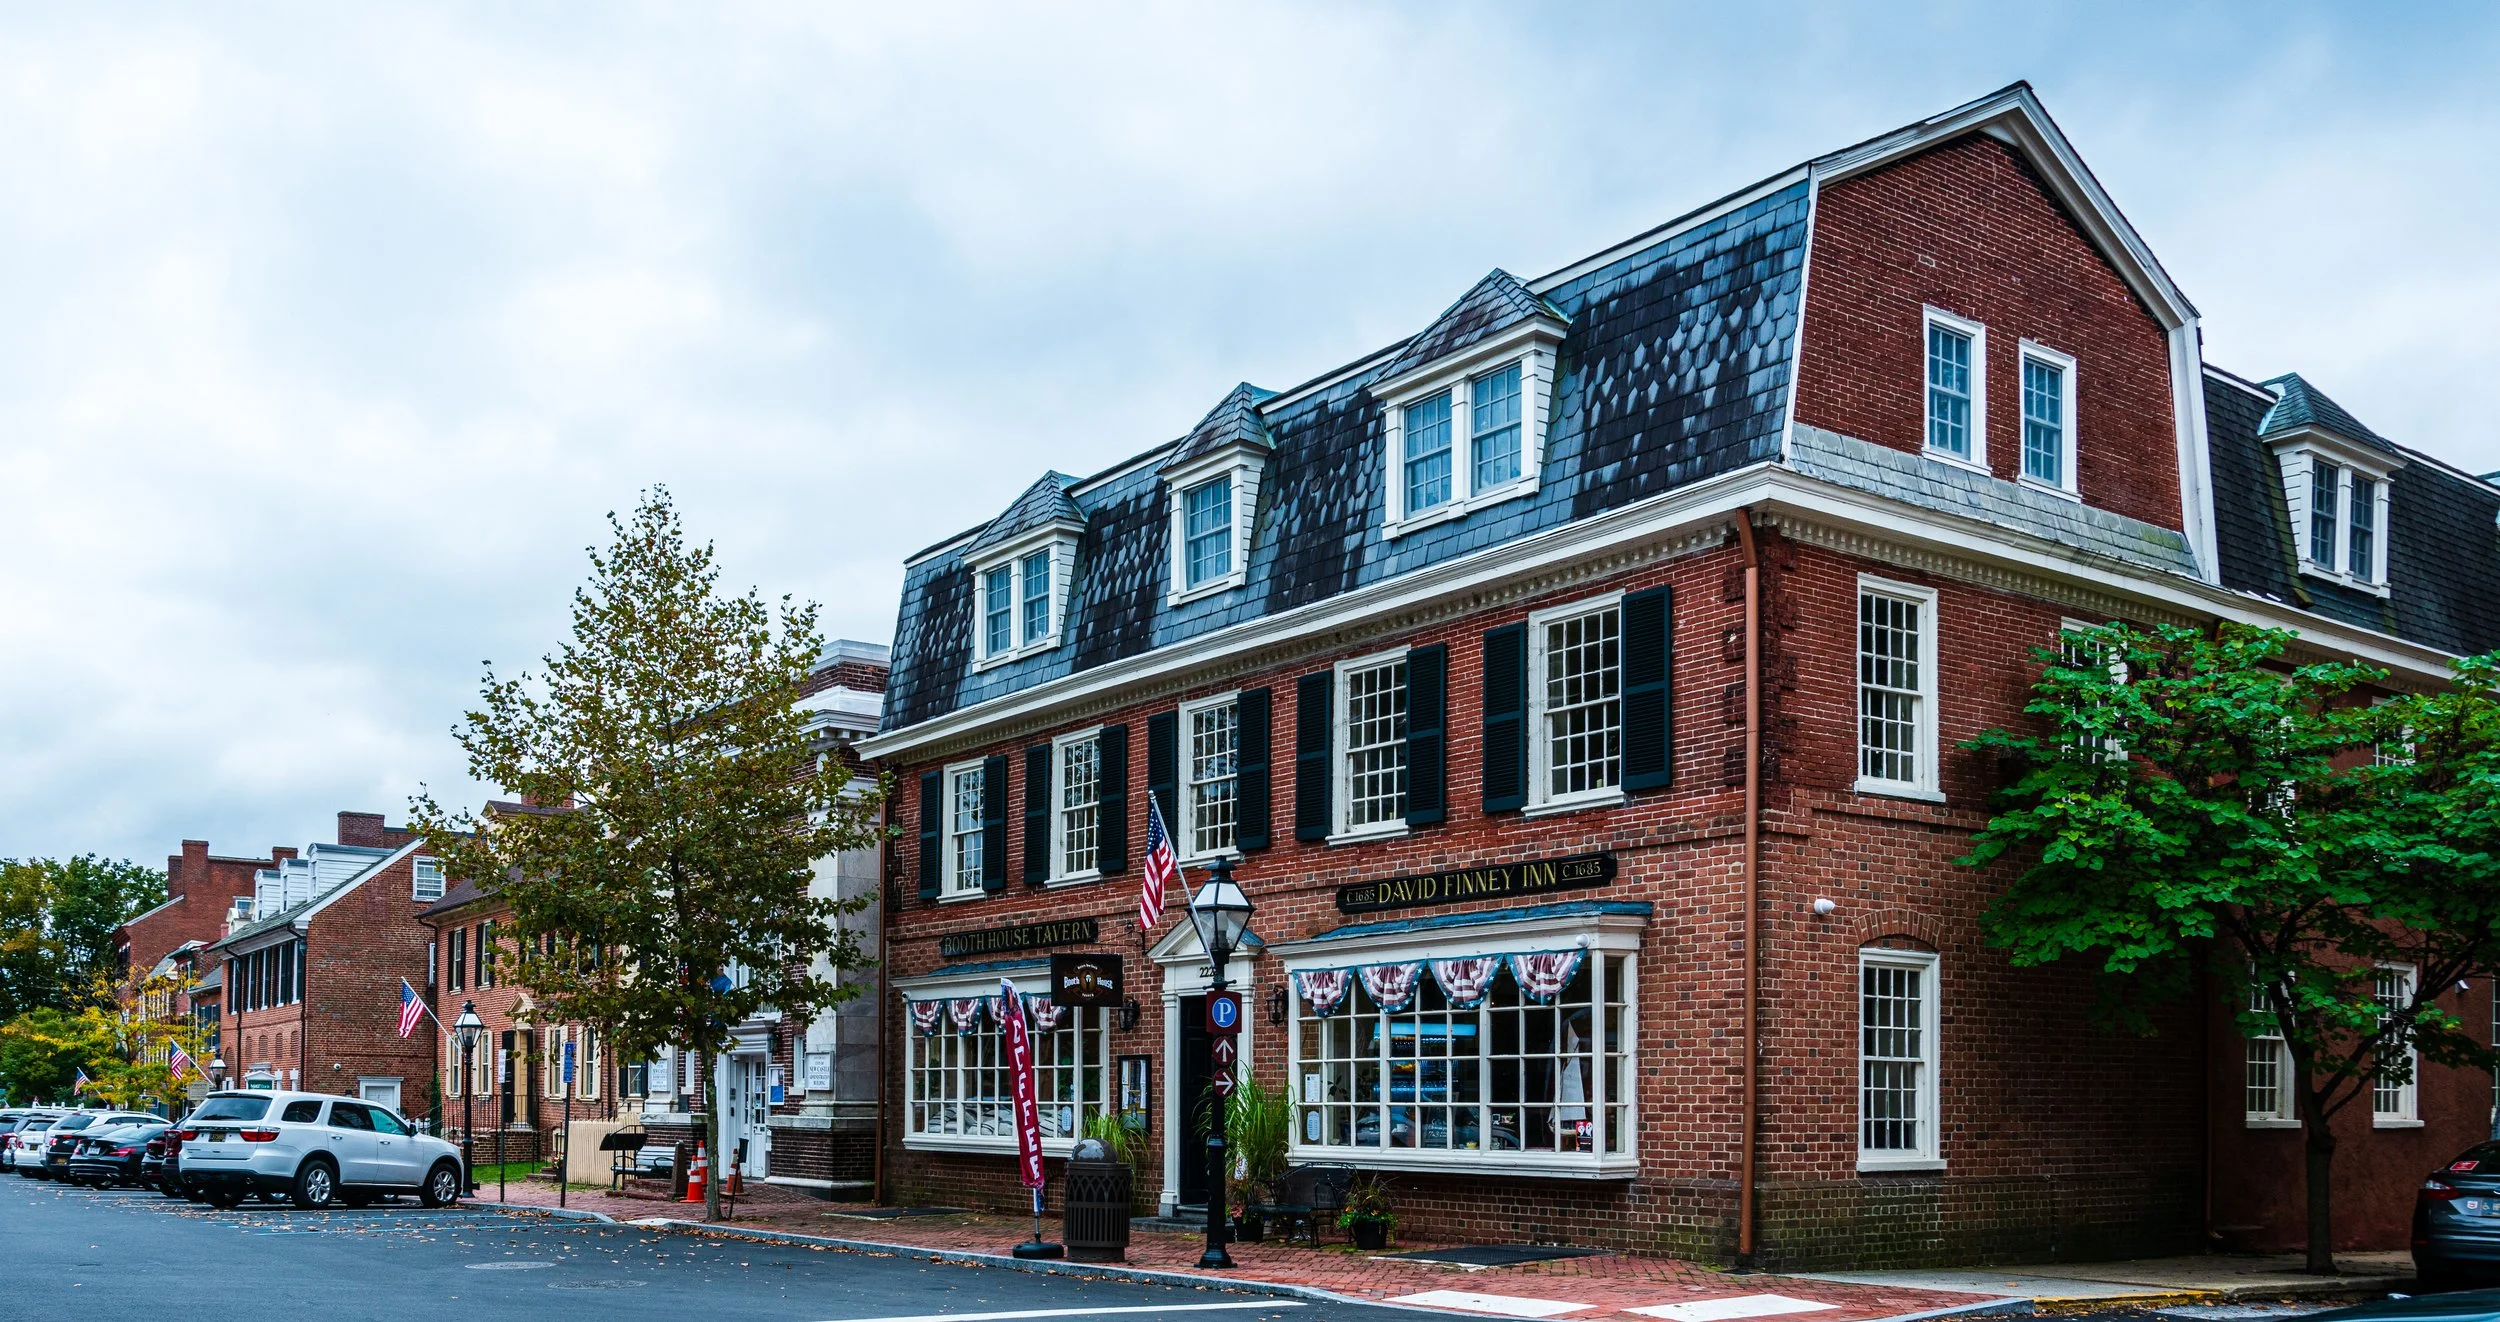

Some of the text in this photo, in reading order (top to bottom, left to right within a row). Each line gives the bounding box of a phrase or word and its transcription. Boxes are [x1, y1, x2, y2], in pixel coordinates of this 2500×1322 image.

[1355, 889, 1375, 902] 1685
[1379, 877, 1437, 904] DAVID
[1444, 866, 1515, 896] FINNEY
[1523, 861, 1557, 888] INN
[1574, 861, 1601, 876] 1685
[944, 921, 1092, 955] BOOTH HOUSE TAVERN
[1217, 1002, 1232, 1023] P
